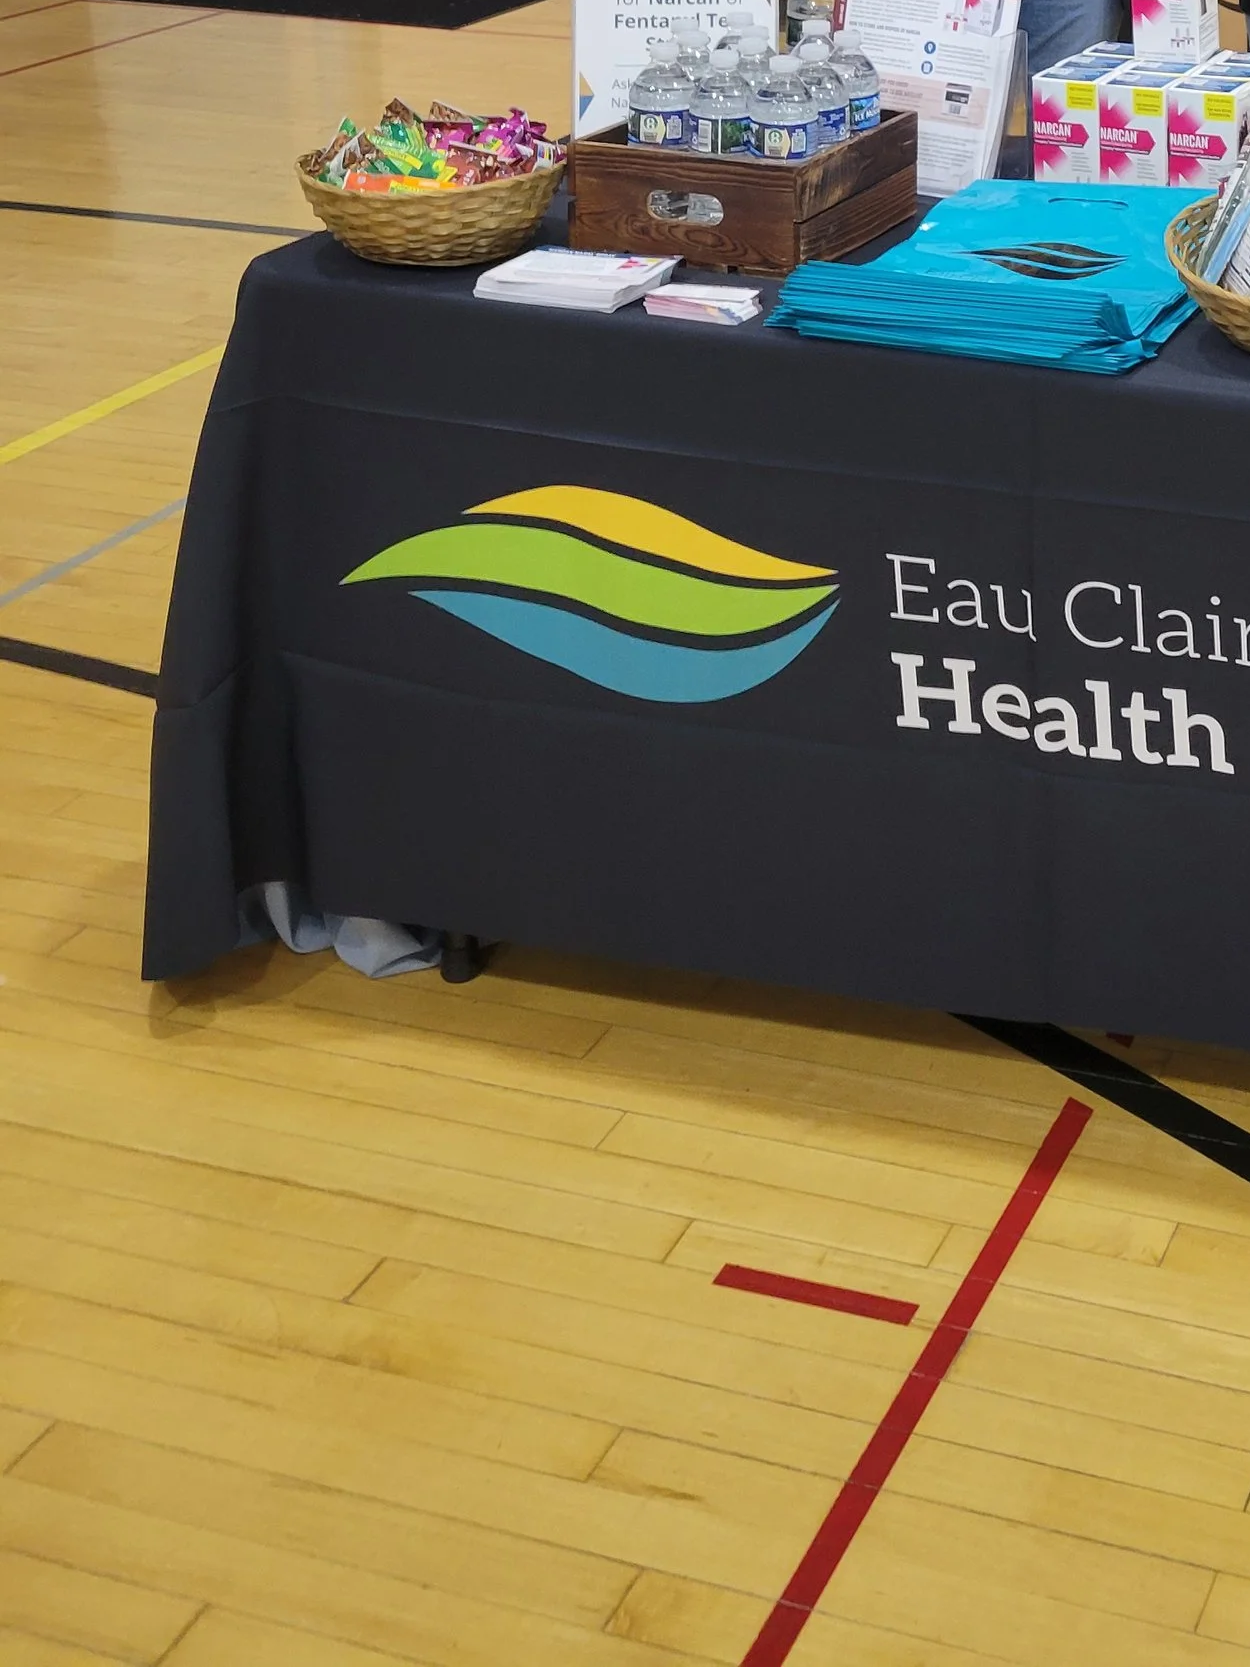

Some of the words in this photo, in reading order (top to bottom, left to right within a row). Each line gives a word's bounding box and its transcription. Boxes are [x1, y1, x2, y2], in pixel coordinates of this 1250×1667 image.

[1033, 121, 1072, 137] NARCAN
[1100, 127, 1138, 144] NARCAN
[1170, 132, 1209, 149] NARCAN
[885, 553, 1037, 643] Eau
[890, 651, 1235, 775] Health
